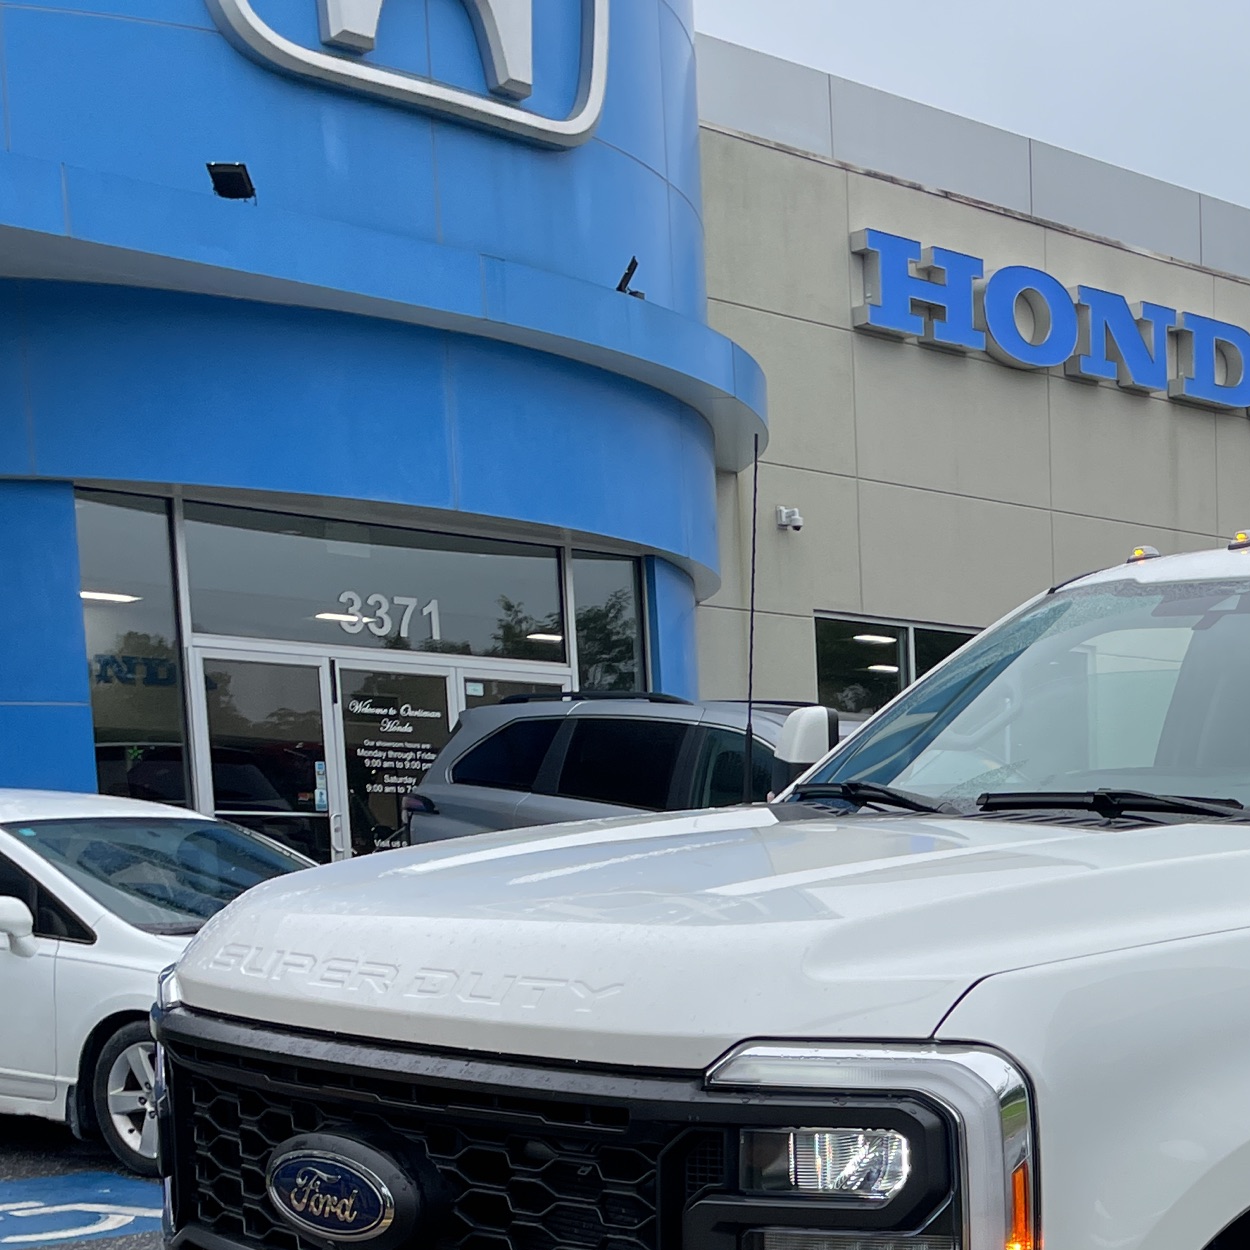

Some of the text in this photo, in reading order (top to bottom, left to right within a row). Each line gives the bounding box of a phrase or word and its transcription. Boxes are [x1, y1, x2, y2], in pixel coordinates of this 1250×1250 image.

[338, 590, 441, 641] 3371
[348, 698, 388, 715] Welcome
[388, 707, 397, 716] to
[379, 717, 413, 733] Honda
[363, 739, 375, 747] Our
[375, 740, 404, 748] showroom
[356, 748, 437, 761] Monday through Frida
[364, 759, 433, 771] 9:00 am to 9:00 pm
[383, 774, 417, 785] Saturday
[365, 783, 383, 793] 9:00
[384, 786, 396, 794] am
[397, 785, 405, 794] to
[209, 941, 625, 1013] SUPER DUTY
[289, 1165, 359, 1225] Ford
